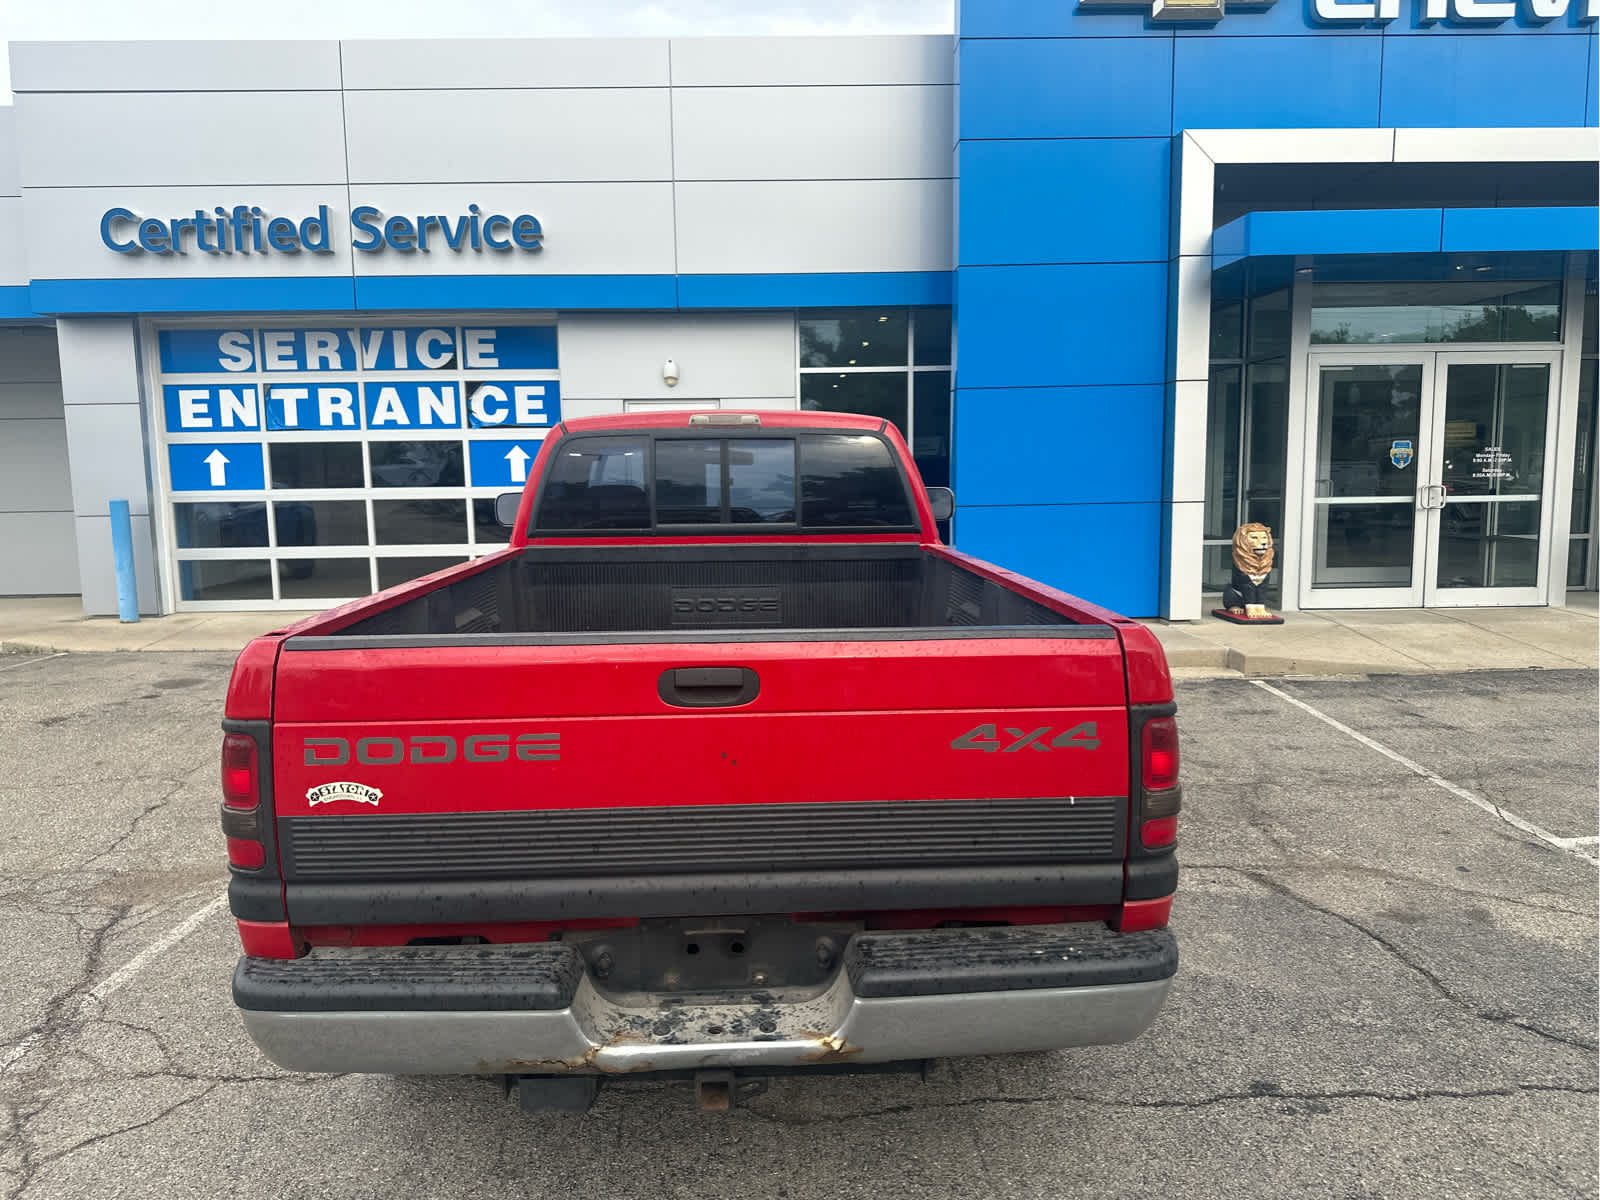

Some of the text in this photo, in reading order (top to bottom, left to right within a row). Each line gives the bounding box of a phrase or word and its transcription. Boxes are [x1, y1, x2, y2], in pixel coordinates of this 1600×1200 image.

[100, 204, 543, 254] Certified Service
[218, 329, 499, 371] SERVICE
[177, 385, 548, 428] ENTRANCE
[673, 597, 778, 613] DODGE
[303, 733, 560, 766] DODGE
